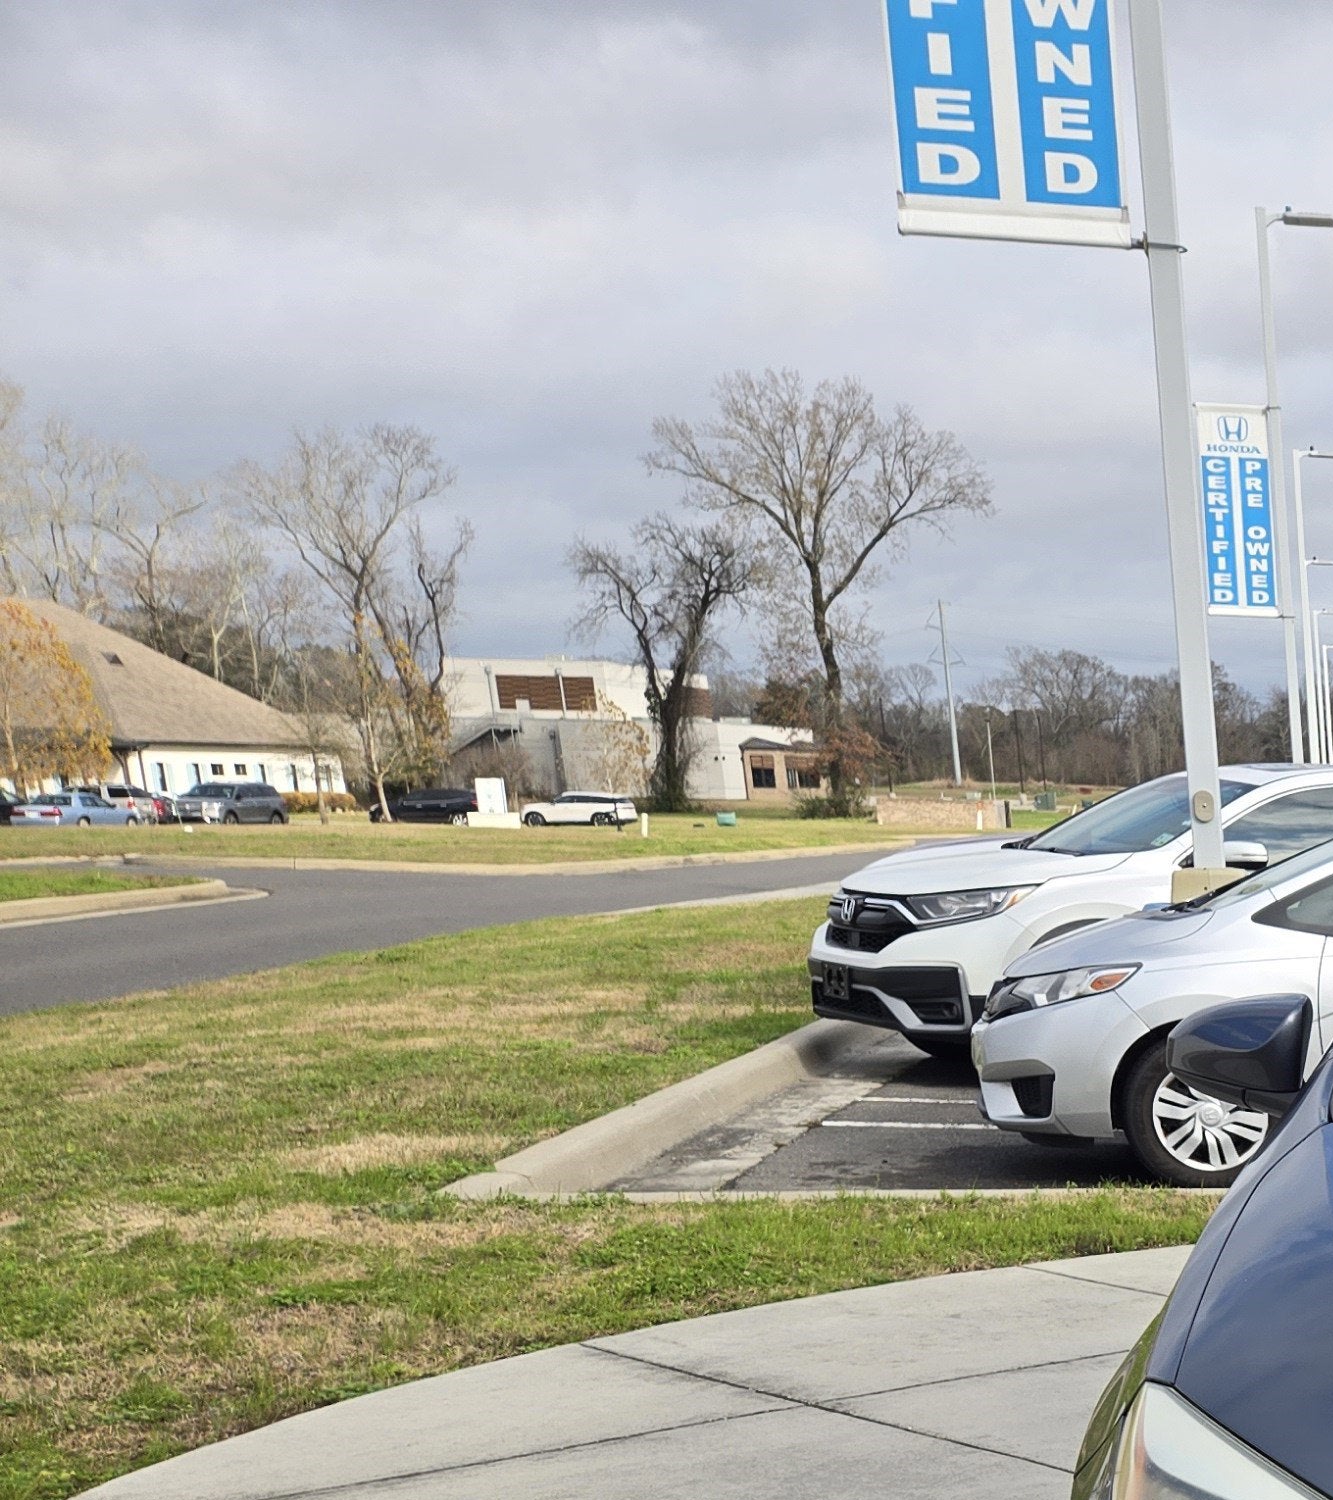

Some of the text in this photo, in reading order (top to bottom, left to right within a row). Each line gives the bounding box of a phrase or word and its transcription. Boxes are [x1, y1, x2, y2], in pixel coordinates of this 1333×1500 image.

[1206, 443, 1261, 454] HONDA
[1206, 459, 1234, 603] CERTIFIED
[1245, 461, 1270, 604] PRE OWNED
